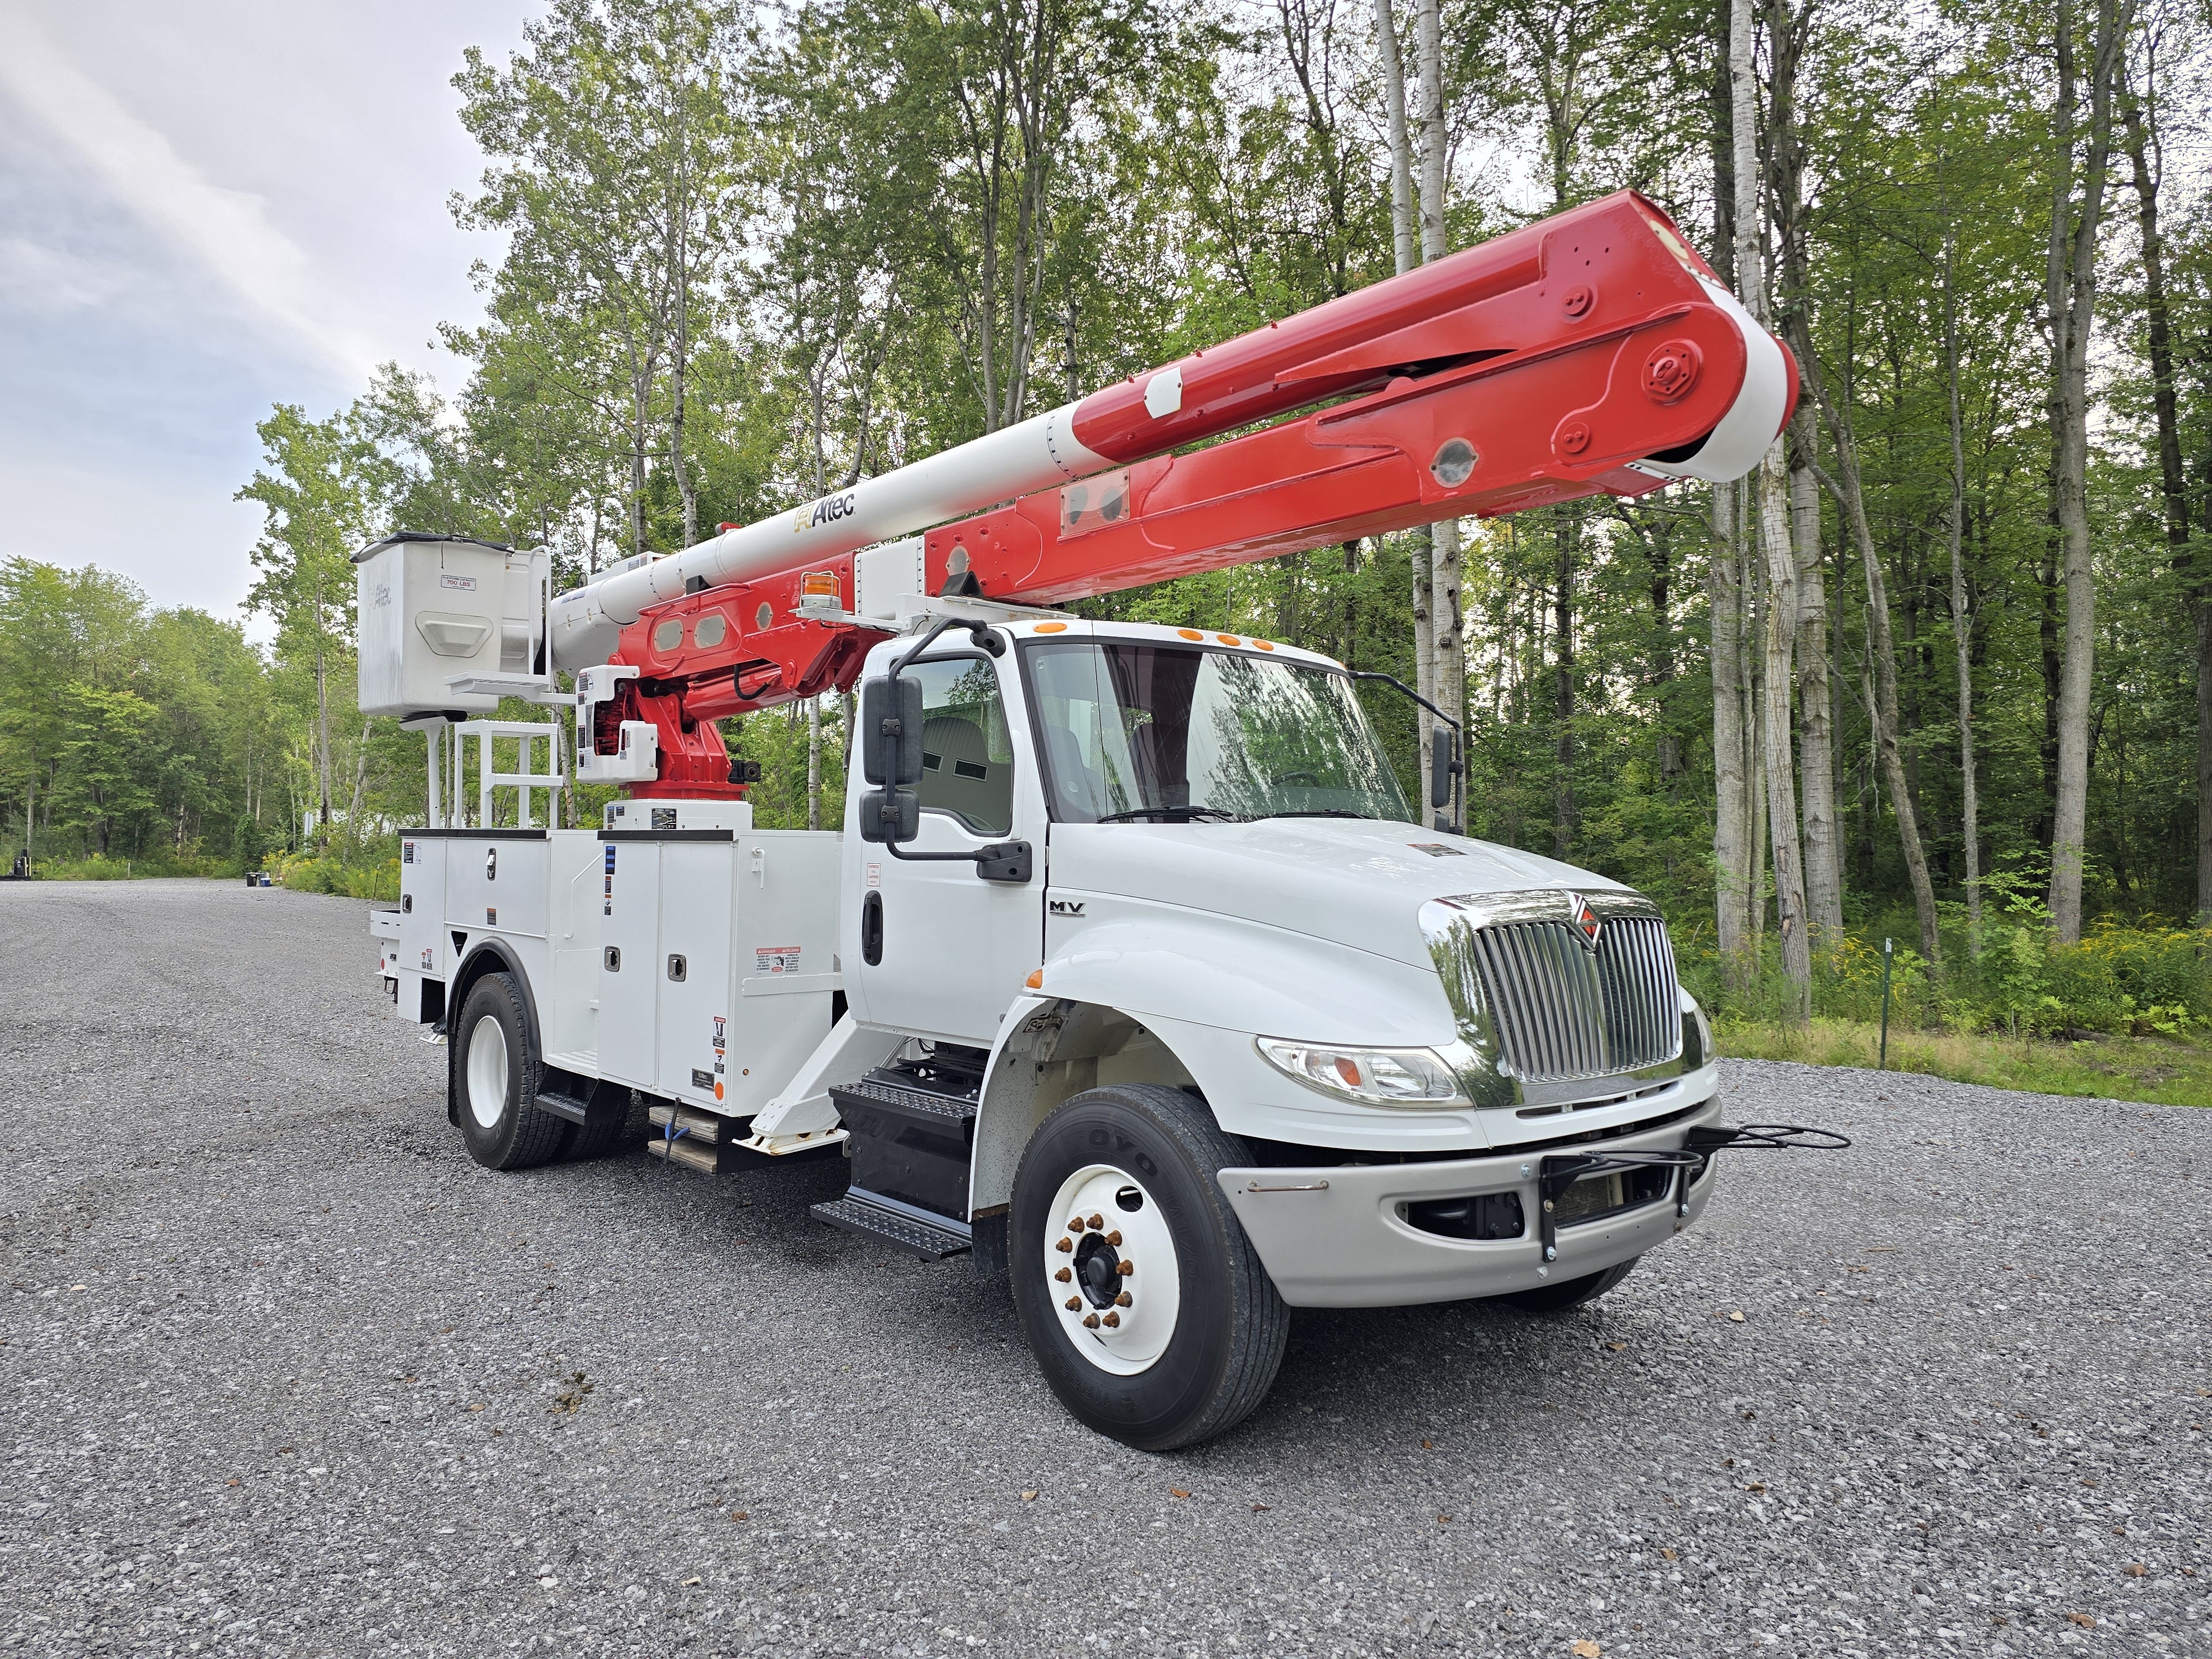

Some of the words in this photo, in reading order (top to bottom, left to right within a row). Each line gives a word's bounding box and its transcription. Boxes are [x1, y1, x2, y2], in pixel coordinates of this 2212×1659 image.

[812, 494, 854, 527] Altec
[1050, 900, 1086, 913] MV
[1063, 1128, 1158, 1177] TOYO
